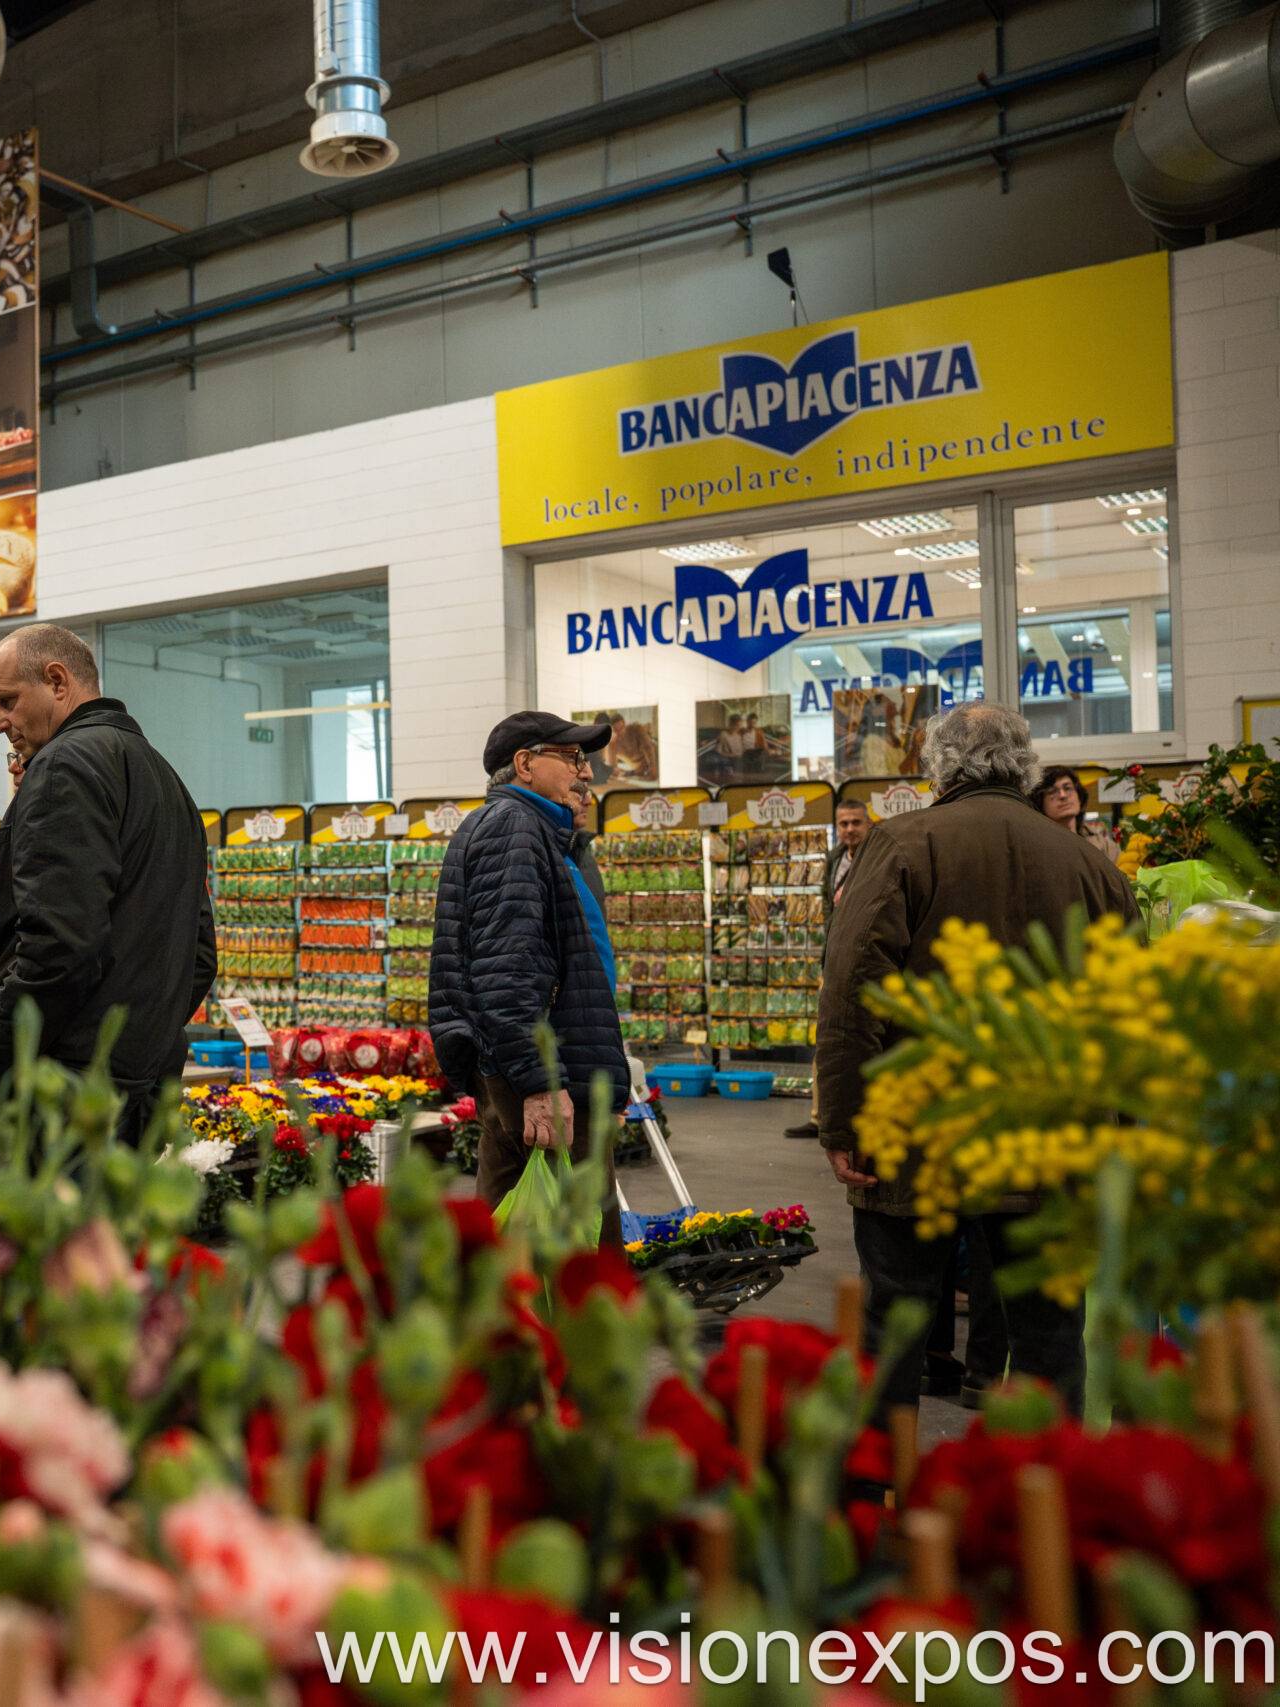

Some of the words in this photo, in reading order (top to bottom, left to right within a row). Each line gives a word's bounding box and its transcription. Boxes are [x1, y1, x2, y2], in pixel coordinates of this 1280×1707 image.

[620, 344, 979, 453] BANCAPIACENZA
[544, 487, 640, 523] locale,
[660, 464, 813, 512] popolare,
[837, 415, 1106, 477] indipendente
[567, 571, 934, 655] BANCAPIACENZA
[758, 806, 795, 819] SCELTO
